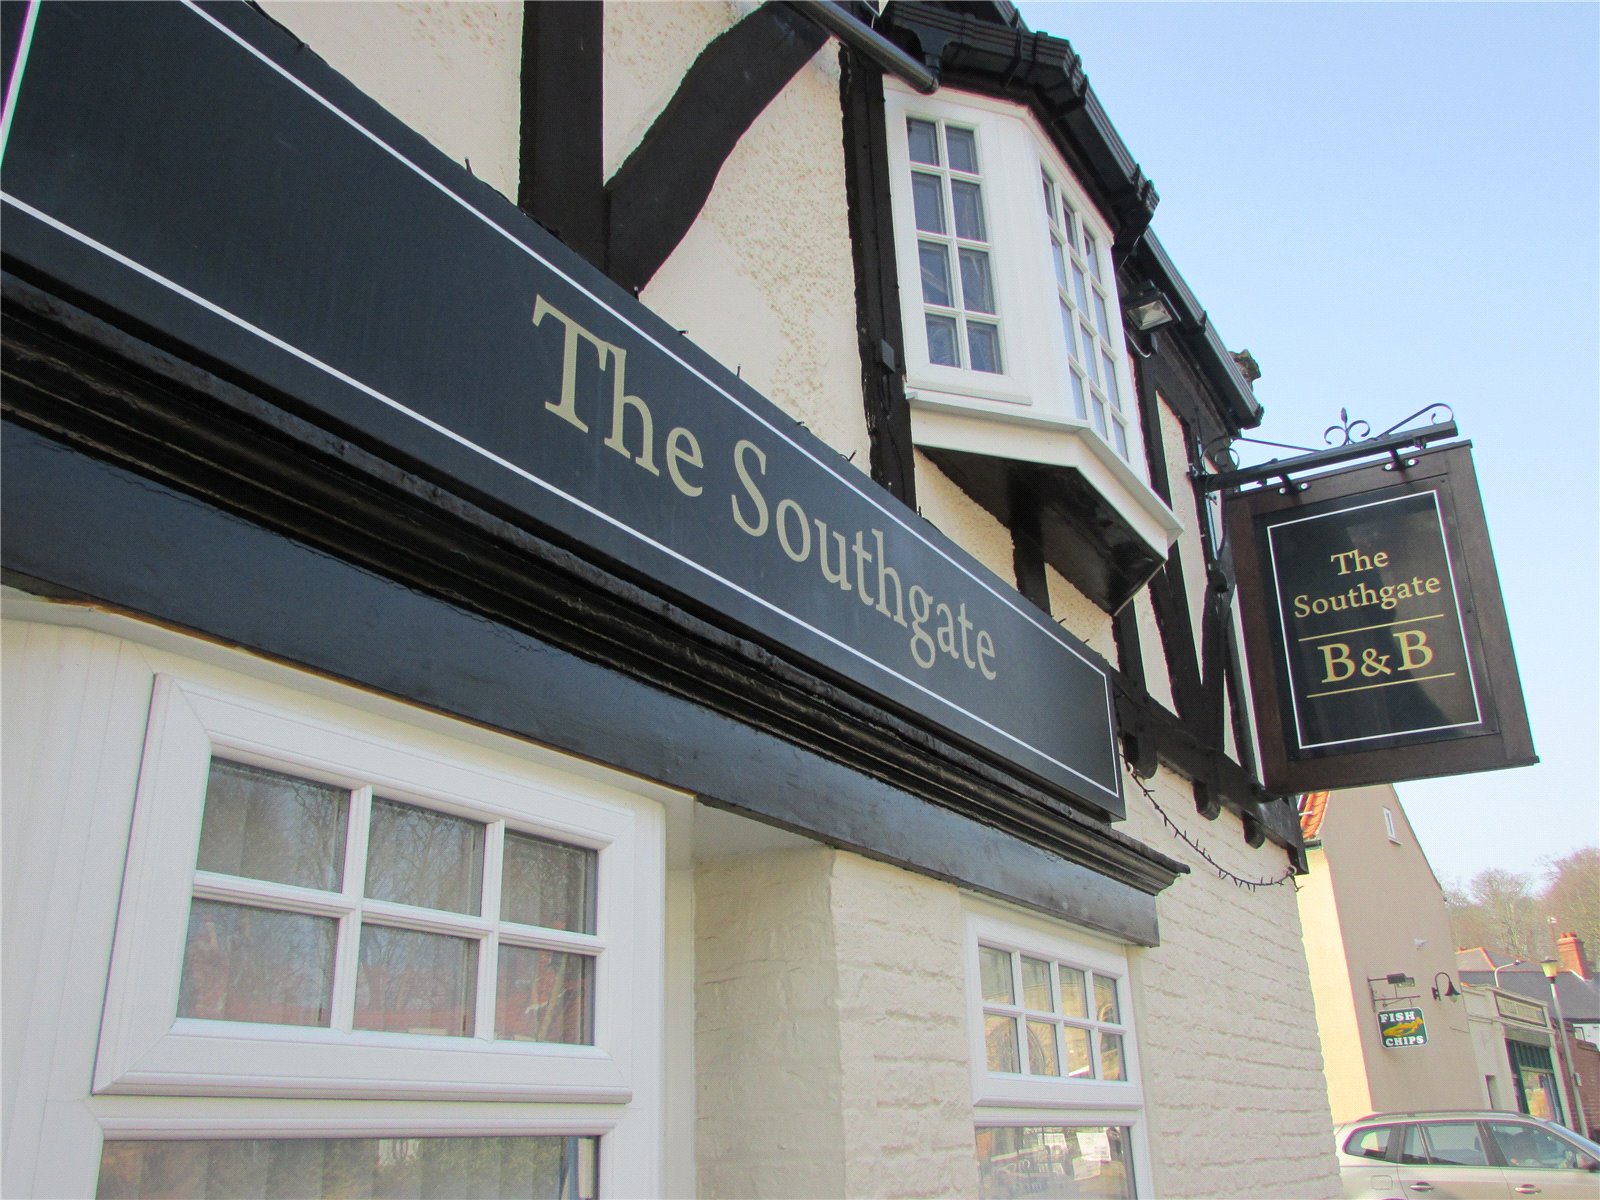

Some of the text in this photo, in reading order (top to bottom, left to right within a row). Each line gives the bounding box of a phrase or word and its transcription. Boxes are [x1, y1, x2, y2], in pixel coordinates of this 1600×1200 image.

[532, 294, 997, 680] The Southgate
[1331, 549, 1389, 575] The
[1294, 576, 1441, 618] Southgate
[1317, 629, 1434, 683] B&B
[1379, 1011, 1416, 1023] FISH
[1385, 1035, 1424, 1047] CHIPS
